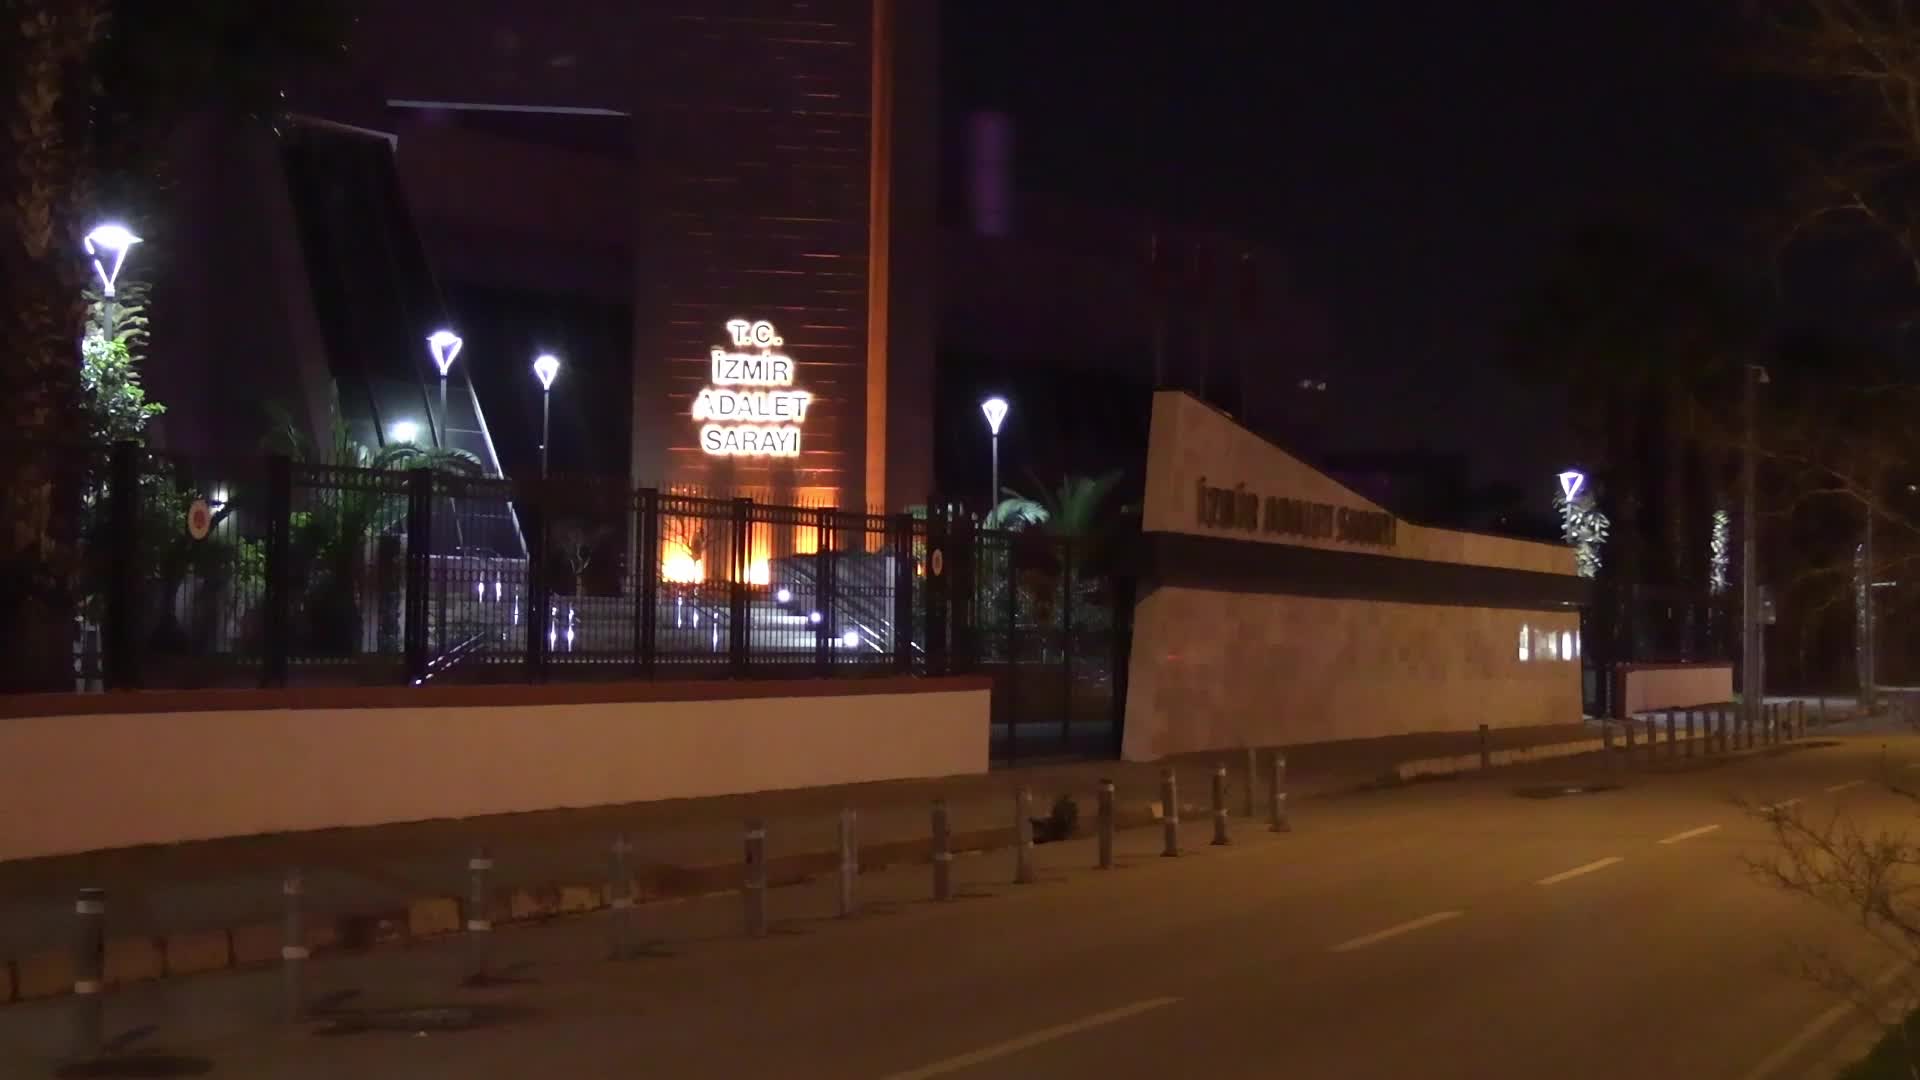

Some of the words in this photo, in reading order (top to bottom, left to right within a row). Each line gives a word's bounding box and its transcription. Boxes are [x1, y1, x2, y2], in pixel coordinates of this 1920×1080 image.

[732, 324, 782, 344] T.C.
[716, 352, 789, 381] İZMİR
[699, 393, 808, 417] ADALET
[705, 429, 798, 452] SARAYI
